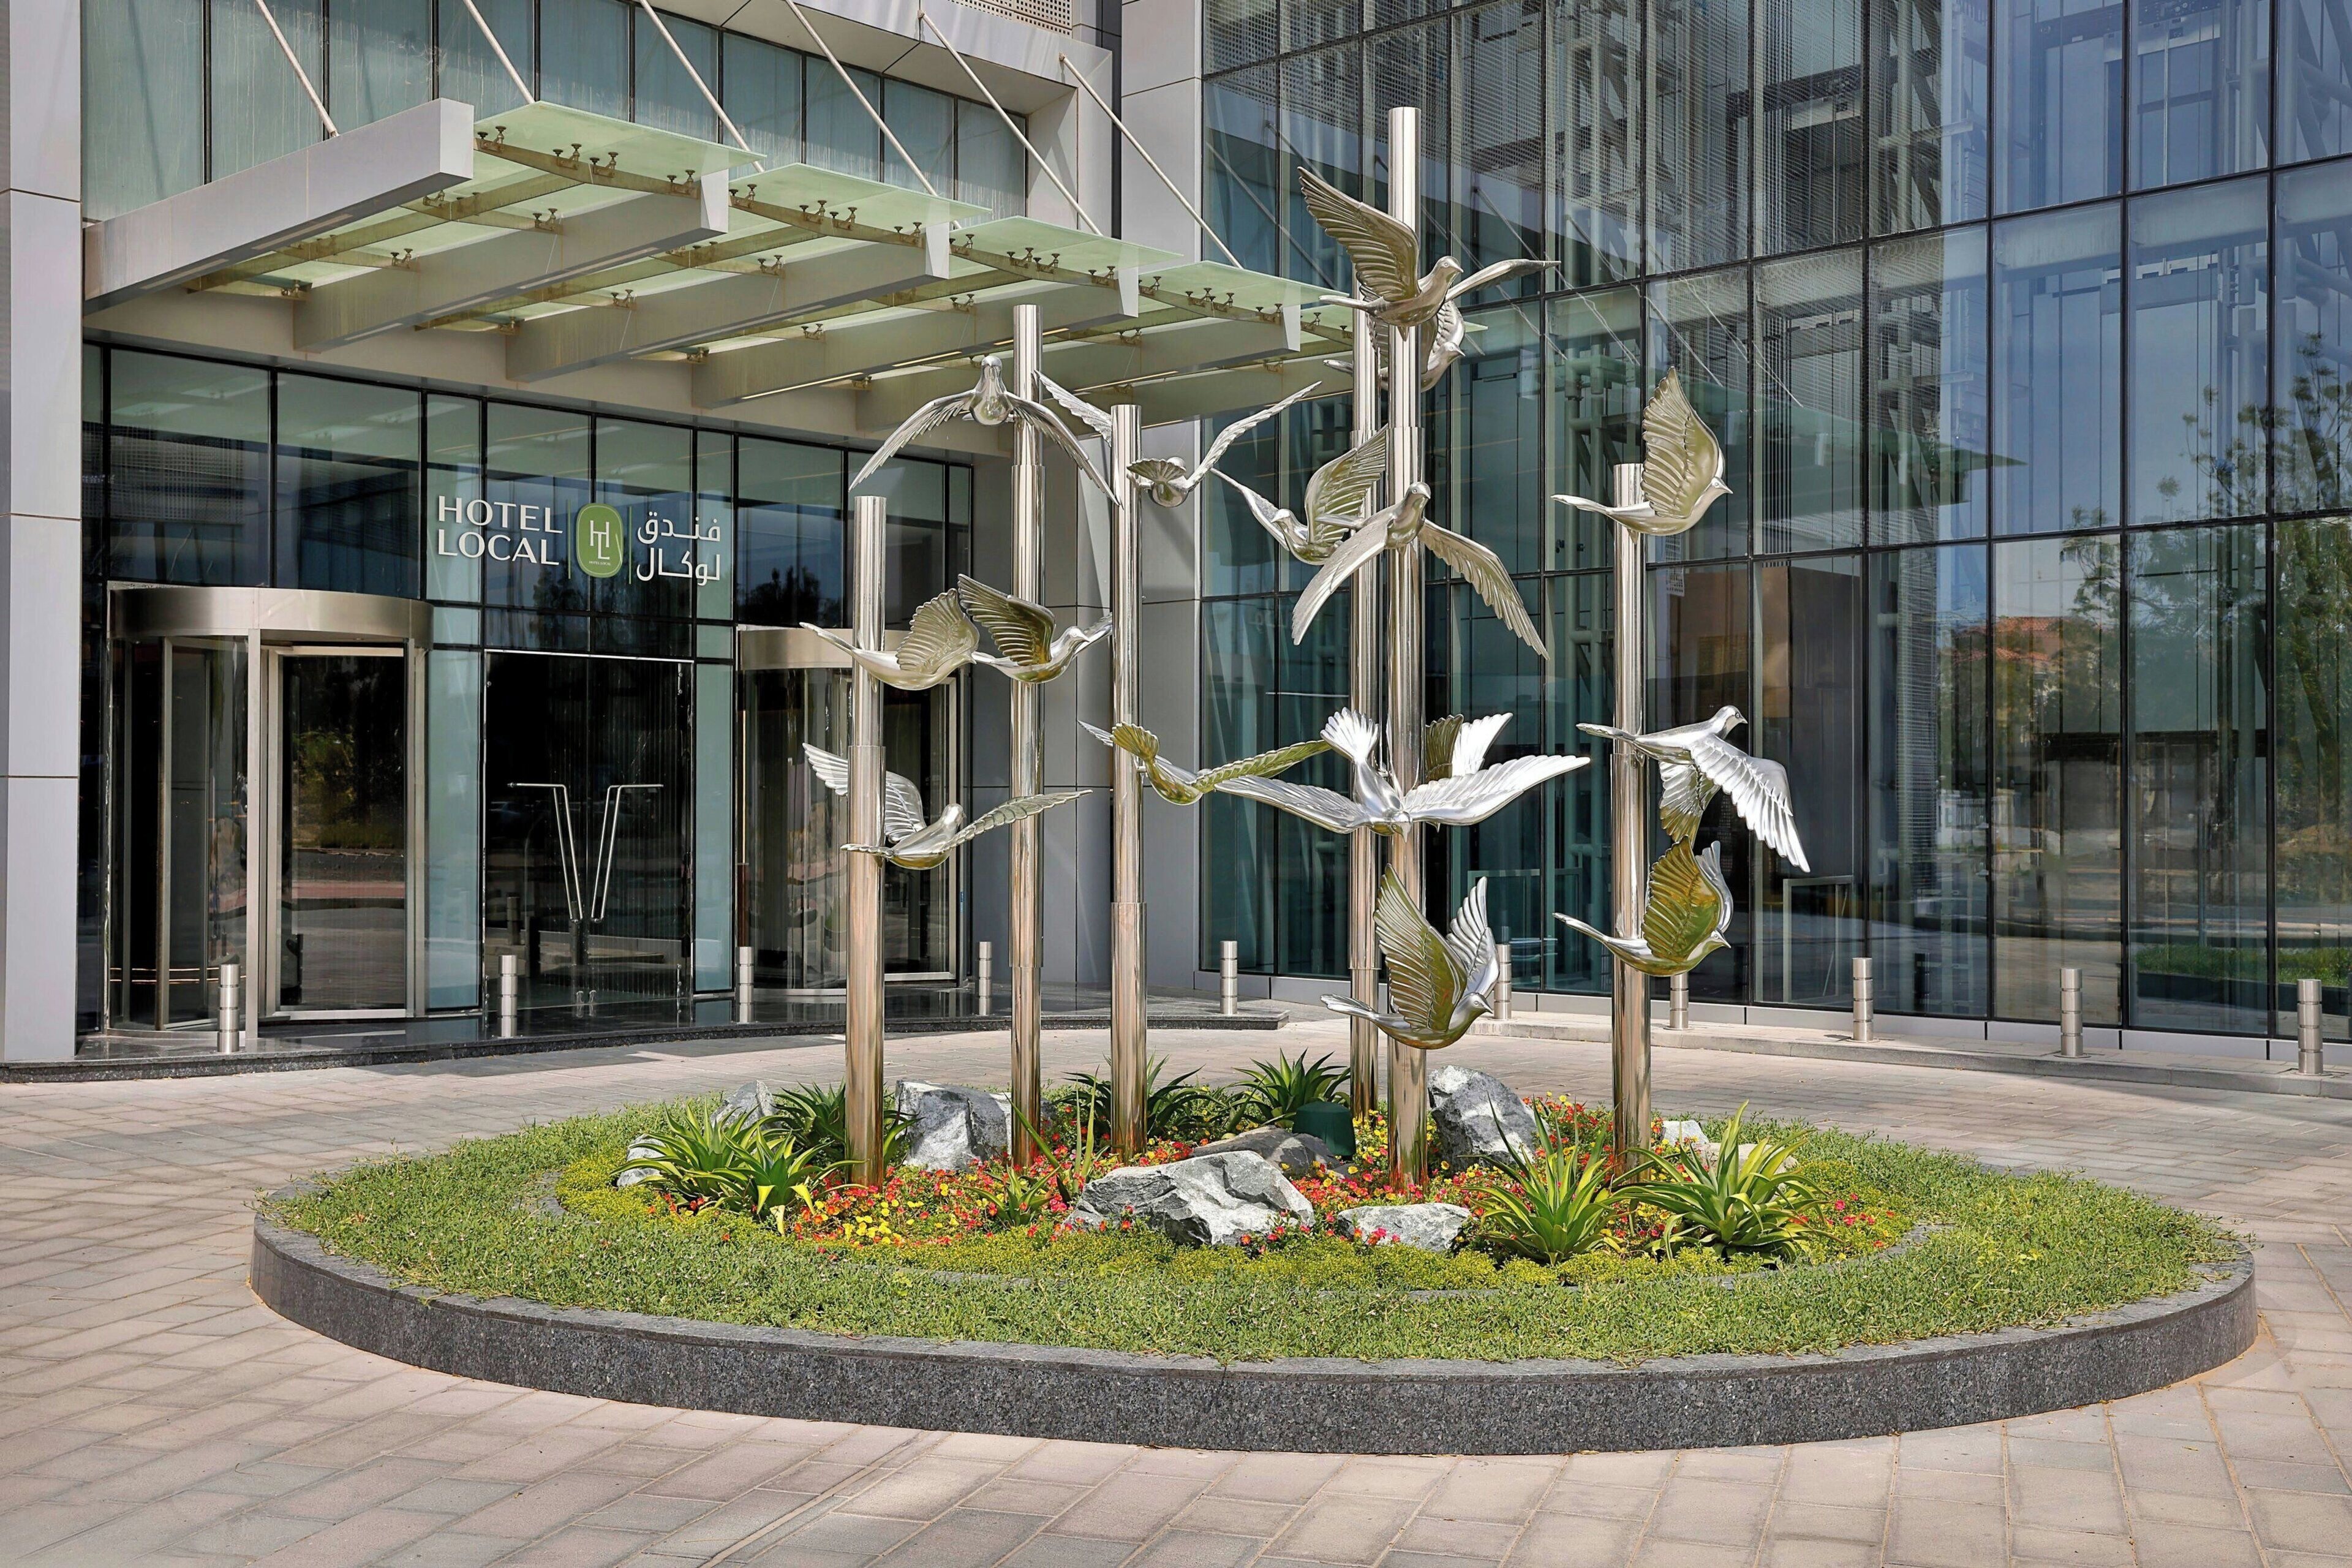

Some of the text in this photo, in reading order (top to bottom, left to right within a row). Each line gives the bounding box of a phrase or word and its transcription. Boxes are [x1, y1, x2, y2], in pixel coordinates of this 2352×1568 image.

[439, 496, 563, 533] HOTEL
[638, 511, 720, 544] فندق
[438, 529, 559, 565] LOCAL
[636, 548, 720, 586] لوكال
